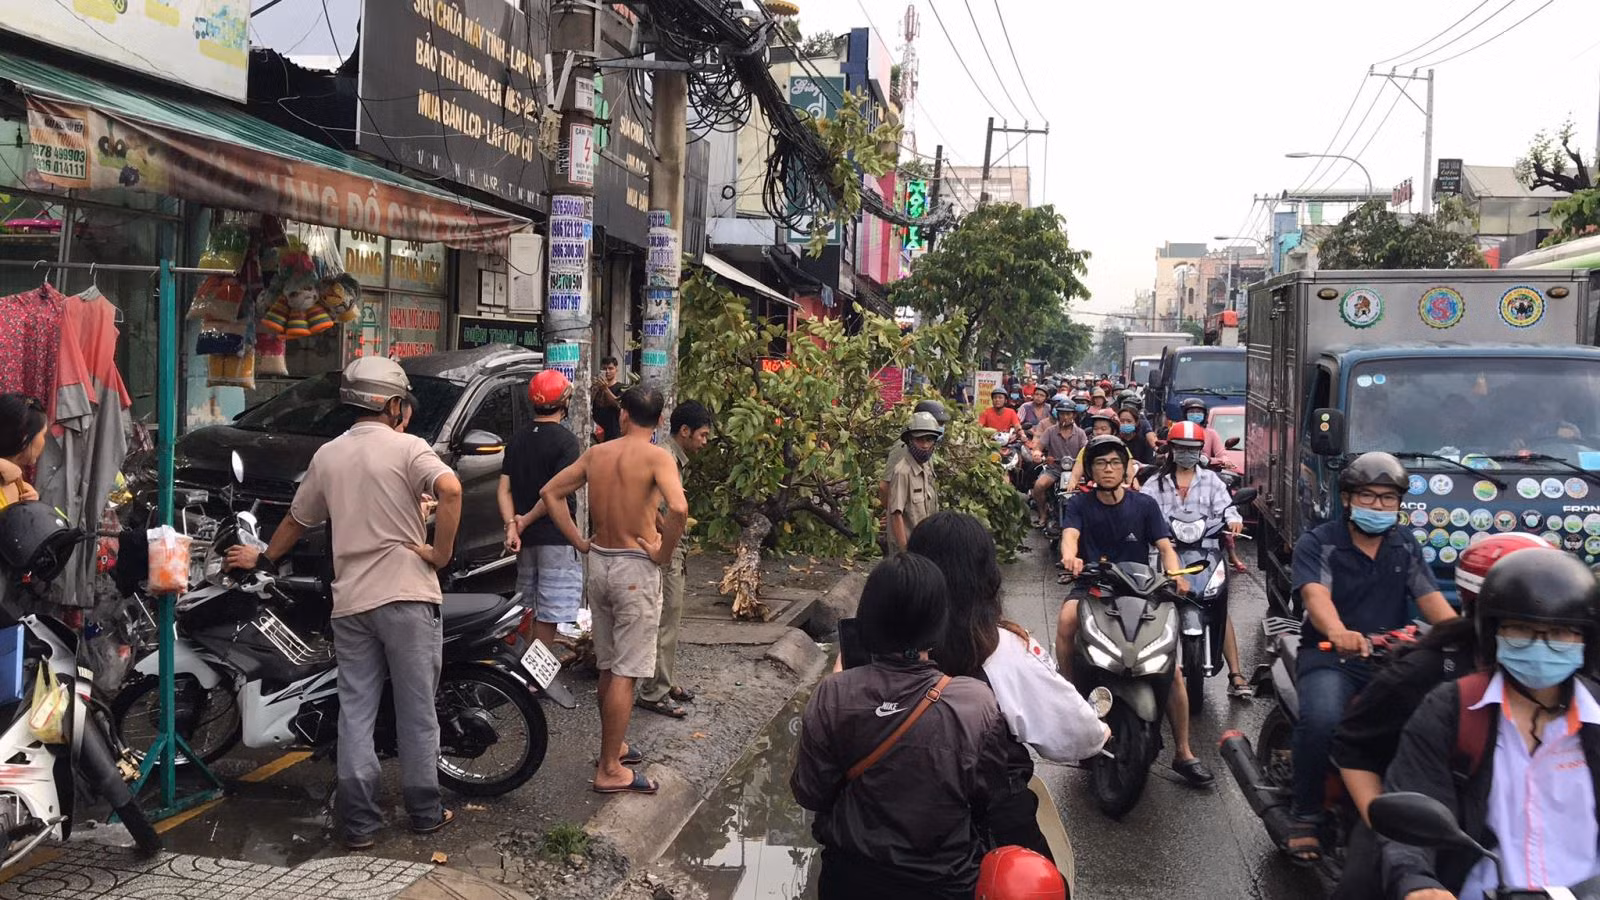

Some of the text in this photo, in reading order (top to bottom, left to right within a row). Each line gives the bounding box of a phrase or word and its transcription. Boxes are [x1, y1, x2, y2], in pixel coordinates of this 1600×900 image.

[436, 1, 463, 38] CHỮA
[464, 17, 484, 50] MÁY
[486, 28, 506, 63] TÍNH
[416, 31, 438, 72] BẢO
[440, 50, 456, 82] TRÌ
[457, 59, 489, 100] PHÒNG
[418, 88, 441, 122] MUA
[442, 97, 463, 132] BÁN
[463, 109, 481, 139] LCD
[486, 120, 520, 156] LAPTOP
[521, 135, 533, 162] CŨ
[347, 178, 381, 230] ĐỒ
[524, 327, 542, 346] MÁ
[1400, 502, 1427, 510] ACO
[1563, 505, 1600, 513] FRON
[881, 701, 900, 711] NIKE
